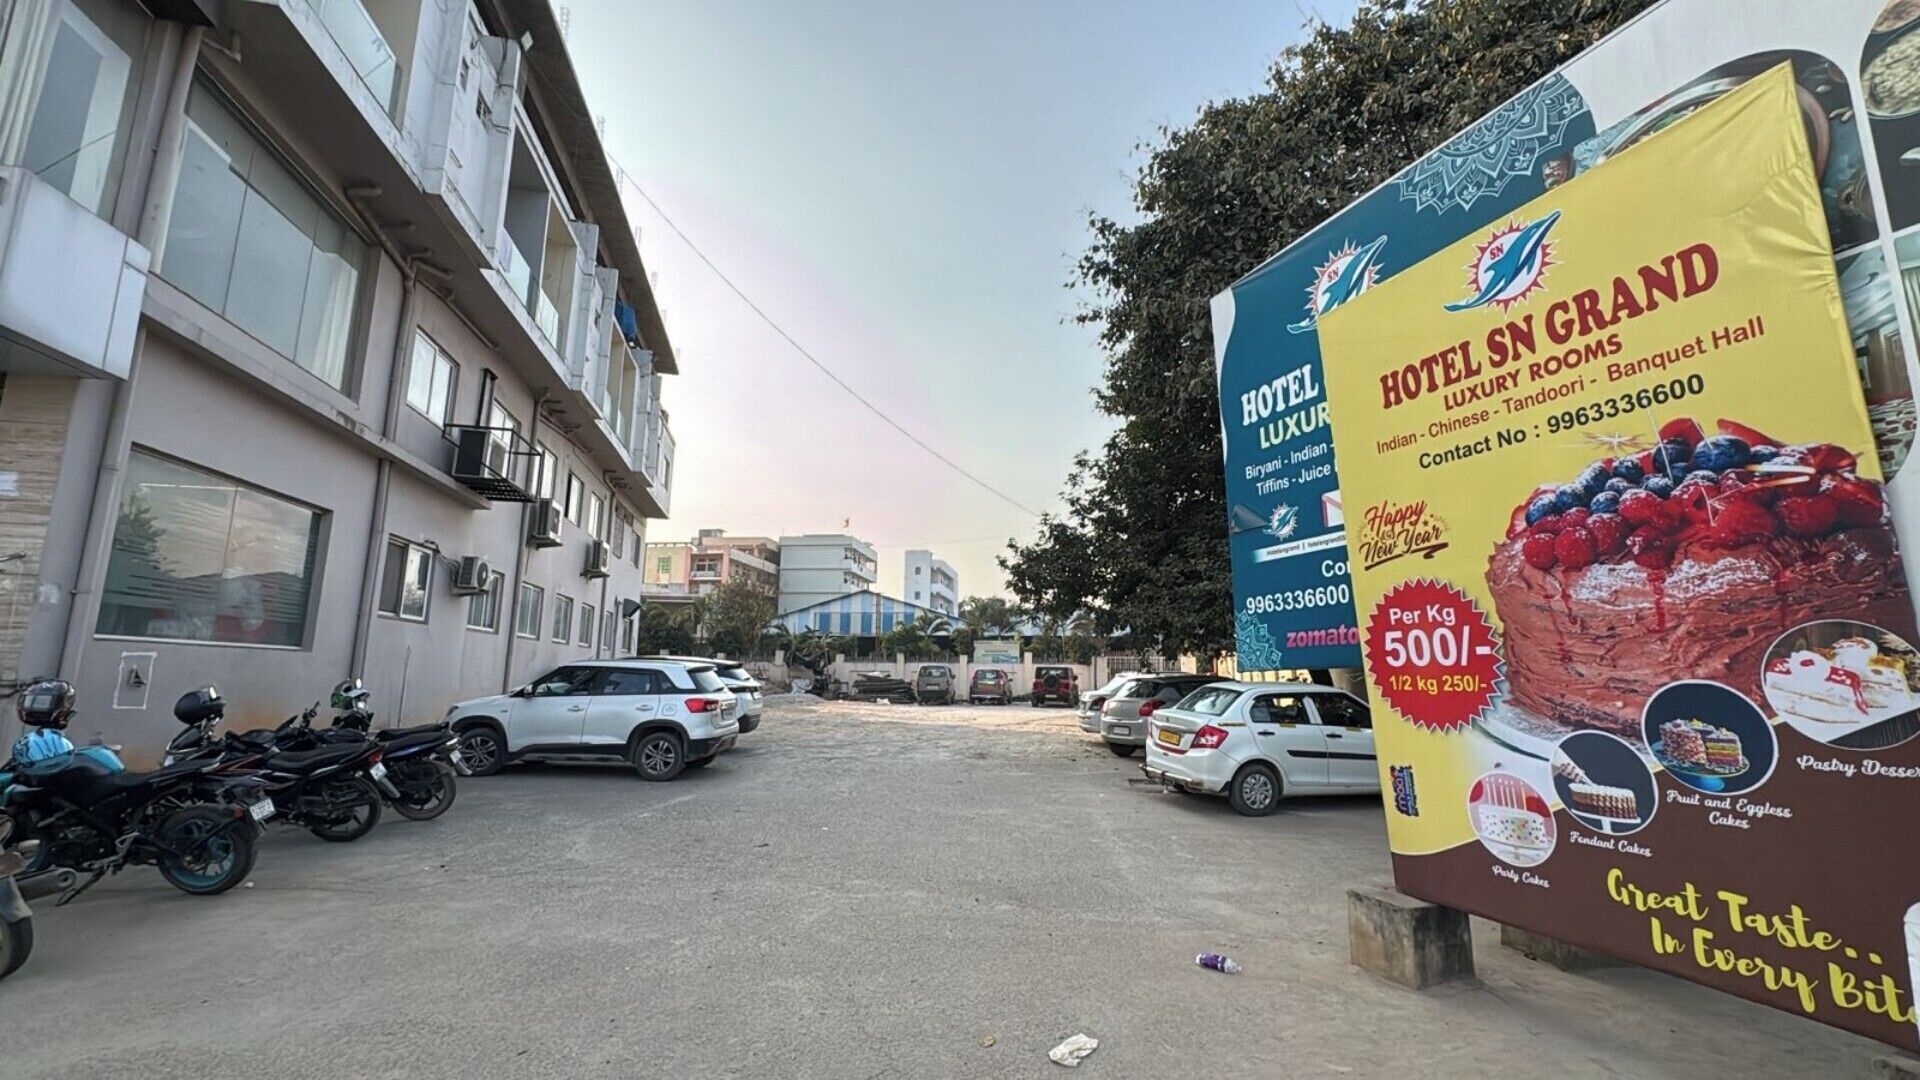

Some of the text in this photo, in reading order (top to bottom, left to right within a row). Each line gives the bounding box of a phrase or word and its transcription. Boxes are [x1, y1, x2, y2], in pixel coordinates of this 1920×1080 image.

[1489, 243, 1504, 260] SN
[1379, 243, 1719, 409] HOTEL SN GRAND
[1376, 431, 1418, 454] Indian
[1428, 408, 1490, 437] Chinese
[1502, 375, 1585, 415] Tandoori
[1607, 336, 1707, 383] Banquet
[1711, 315, 1765, 350] Hall
[1443, 333, 1623, 411] LUXURY ROOMS
[1241, 364, 1319, 426] HOTEL
[1420, 437, 1492, 469] Contact
[1496, 428, 1527, 448] No
[1547, 373, 1705, 433] 9963336600
[1246, 458, 1282, 480] Biryani
[1291, 443, 1327, 466] Indian
[1256, 475, 1289, 496] Tiffins
[1299, 464, 1331, 484] Juice
[1364, 500, 1427, 539] Happy
[1359, 540, 1398, 562] New
[1397, 525, 1442, 553] Year
[1246, 584, 1350, 615] 9963336600
[1389, 604, 1455, 626] Per Kg
[1286, 624, 1359, 648] zomato
[1384, 625, 1492, 667] 500/-
[1389, 675, 1487, 695] 1/2 kg 250/-
[1796, 755, 1857, 778] Pastry
[1666, 789, 1793, 818] Fruit and Eggless
[1709, 811, 1750, 829] Cakes
[1569, 831, 1652, 857] Fondant Cakes
[1492, 864, 1550, 888] Party Cakes
[1606, 868, 1709, 921] Great
[1651, 917, 1686, 954] In
[1693, 928, 1818, 1013] Every
